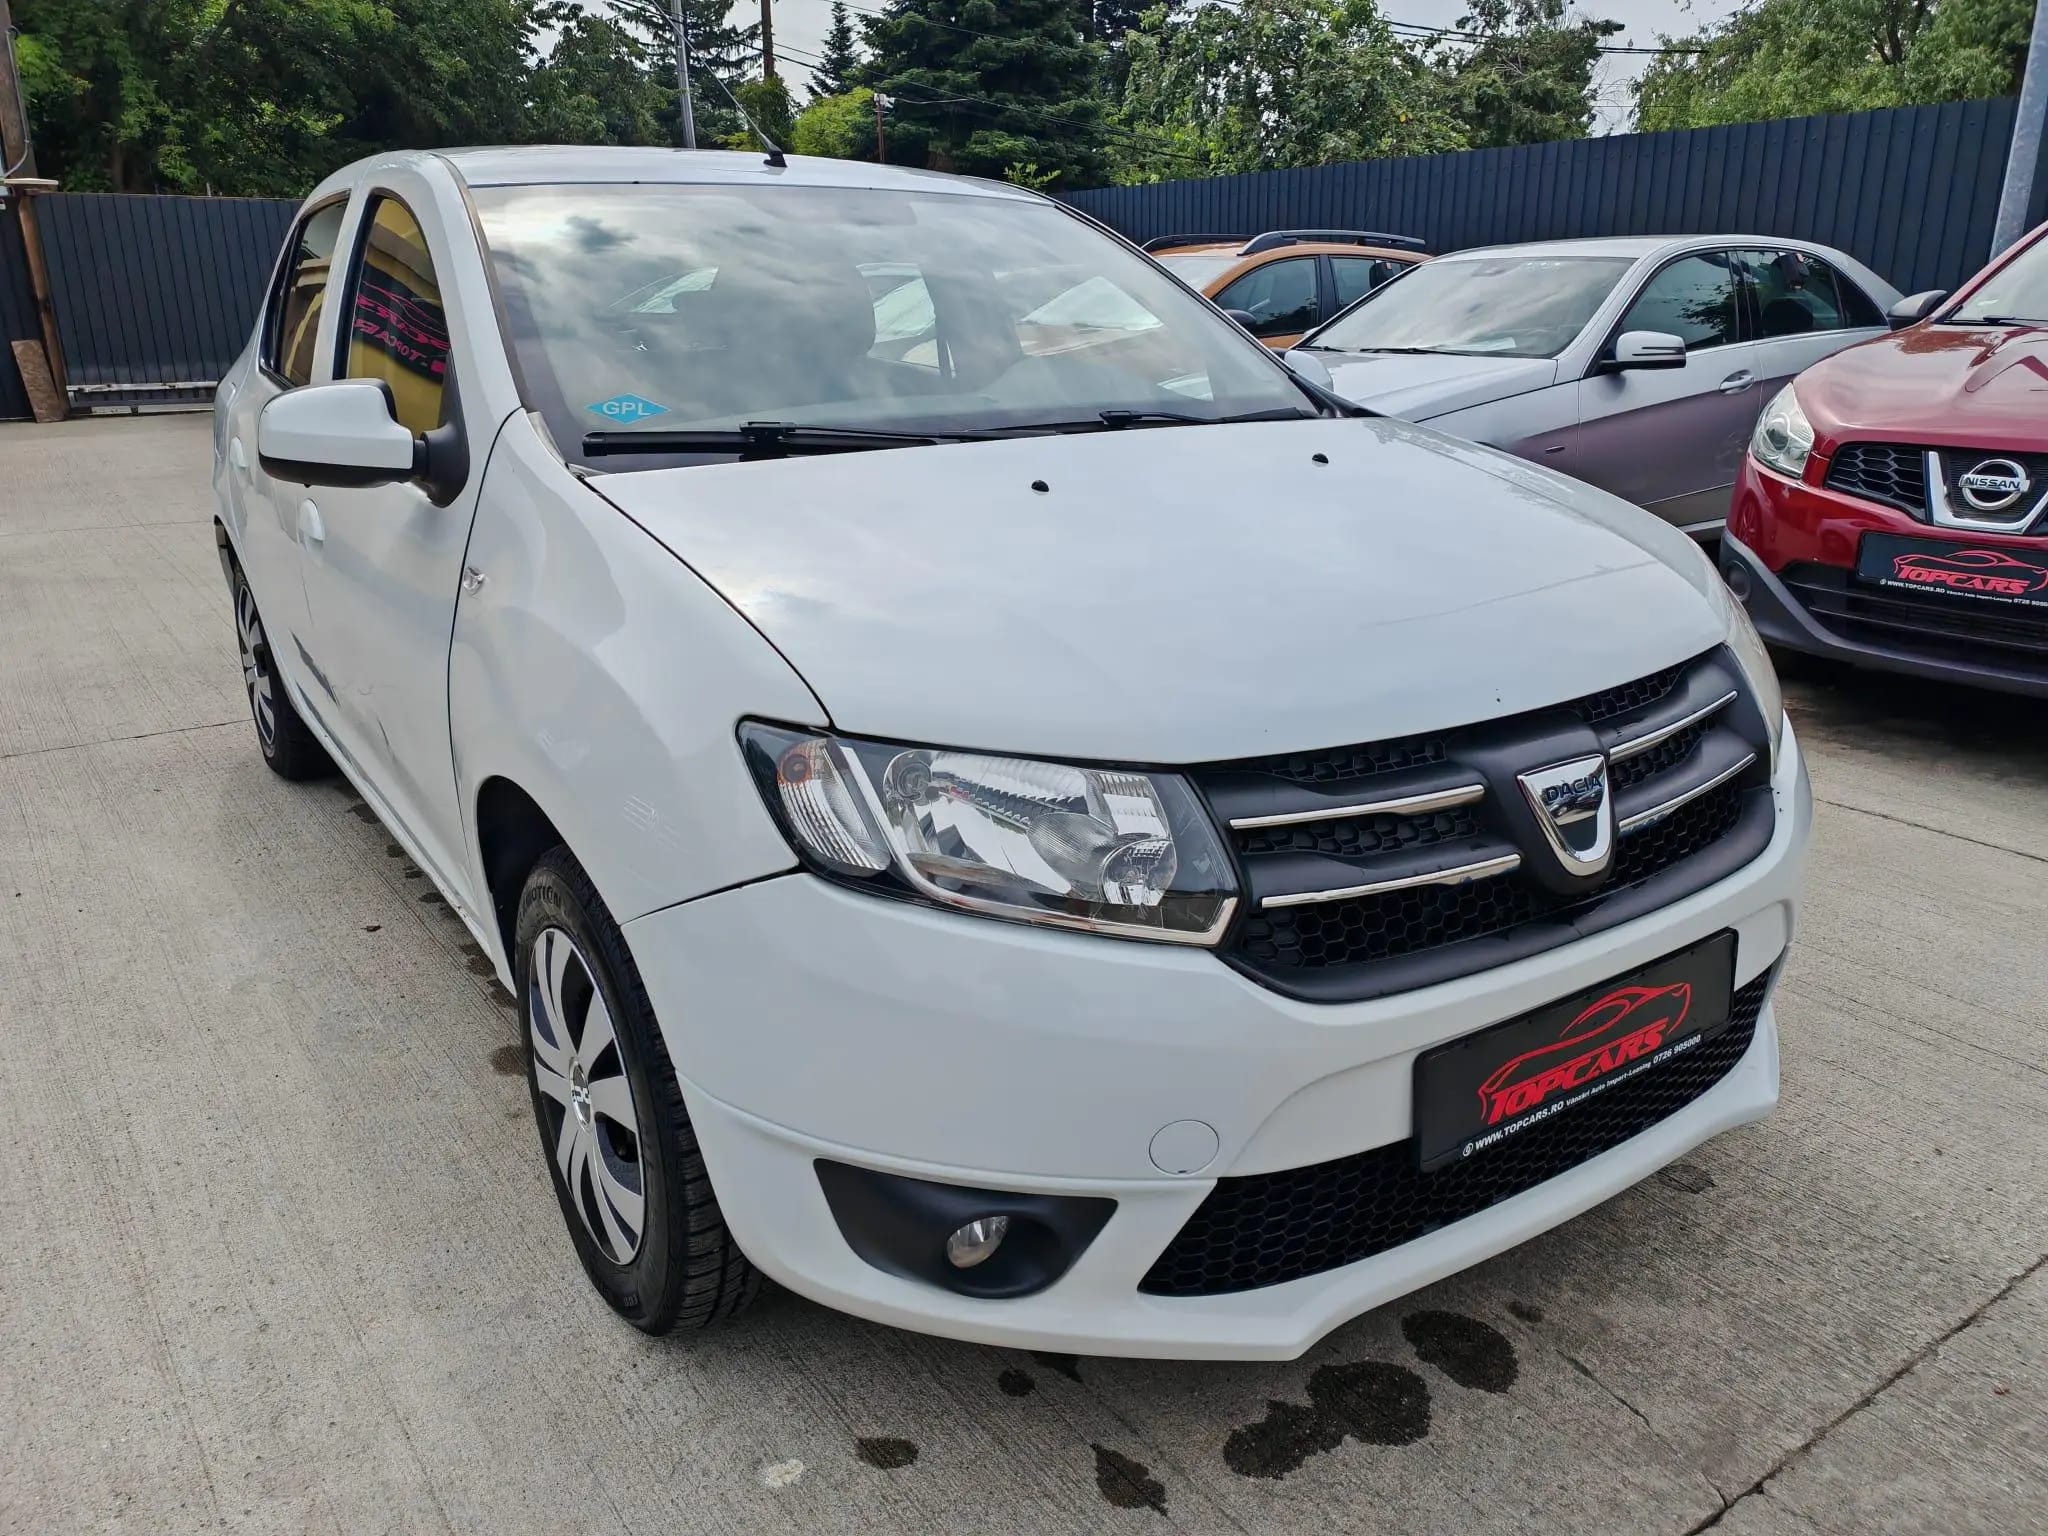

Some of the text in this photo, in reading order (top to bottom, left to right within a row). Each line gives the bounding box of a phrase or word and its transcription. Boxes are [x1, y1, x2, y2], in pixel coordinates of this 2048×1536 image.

[602, 401, 653, 416] GPL
[1965, 476, 2021, 489] NISSAN
[1897, 564, 2031, 595] TOPCARS
[1544, 775, 1602, 802] DACIA
[1488, 1017, 1670, 1125] TOPCARS
[1475, 1101, 1564, 1150] WWW.TOPCARS.RO
[1590, 1083, 1606, 1096] Auto
[1606, 1061, 1652, 1087] Import-Leasing
[1653, 1048, 1672, 1065] 0726
[1673, 1034, 1702, 1054] 905000
